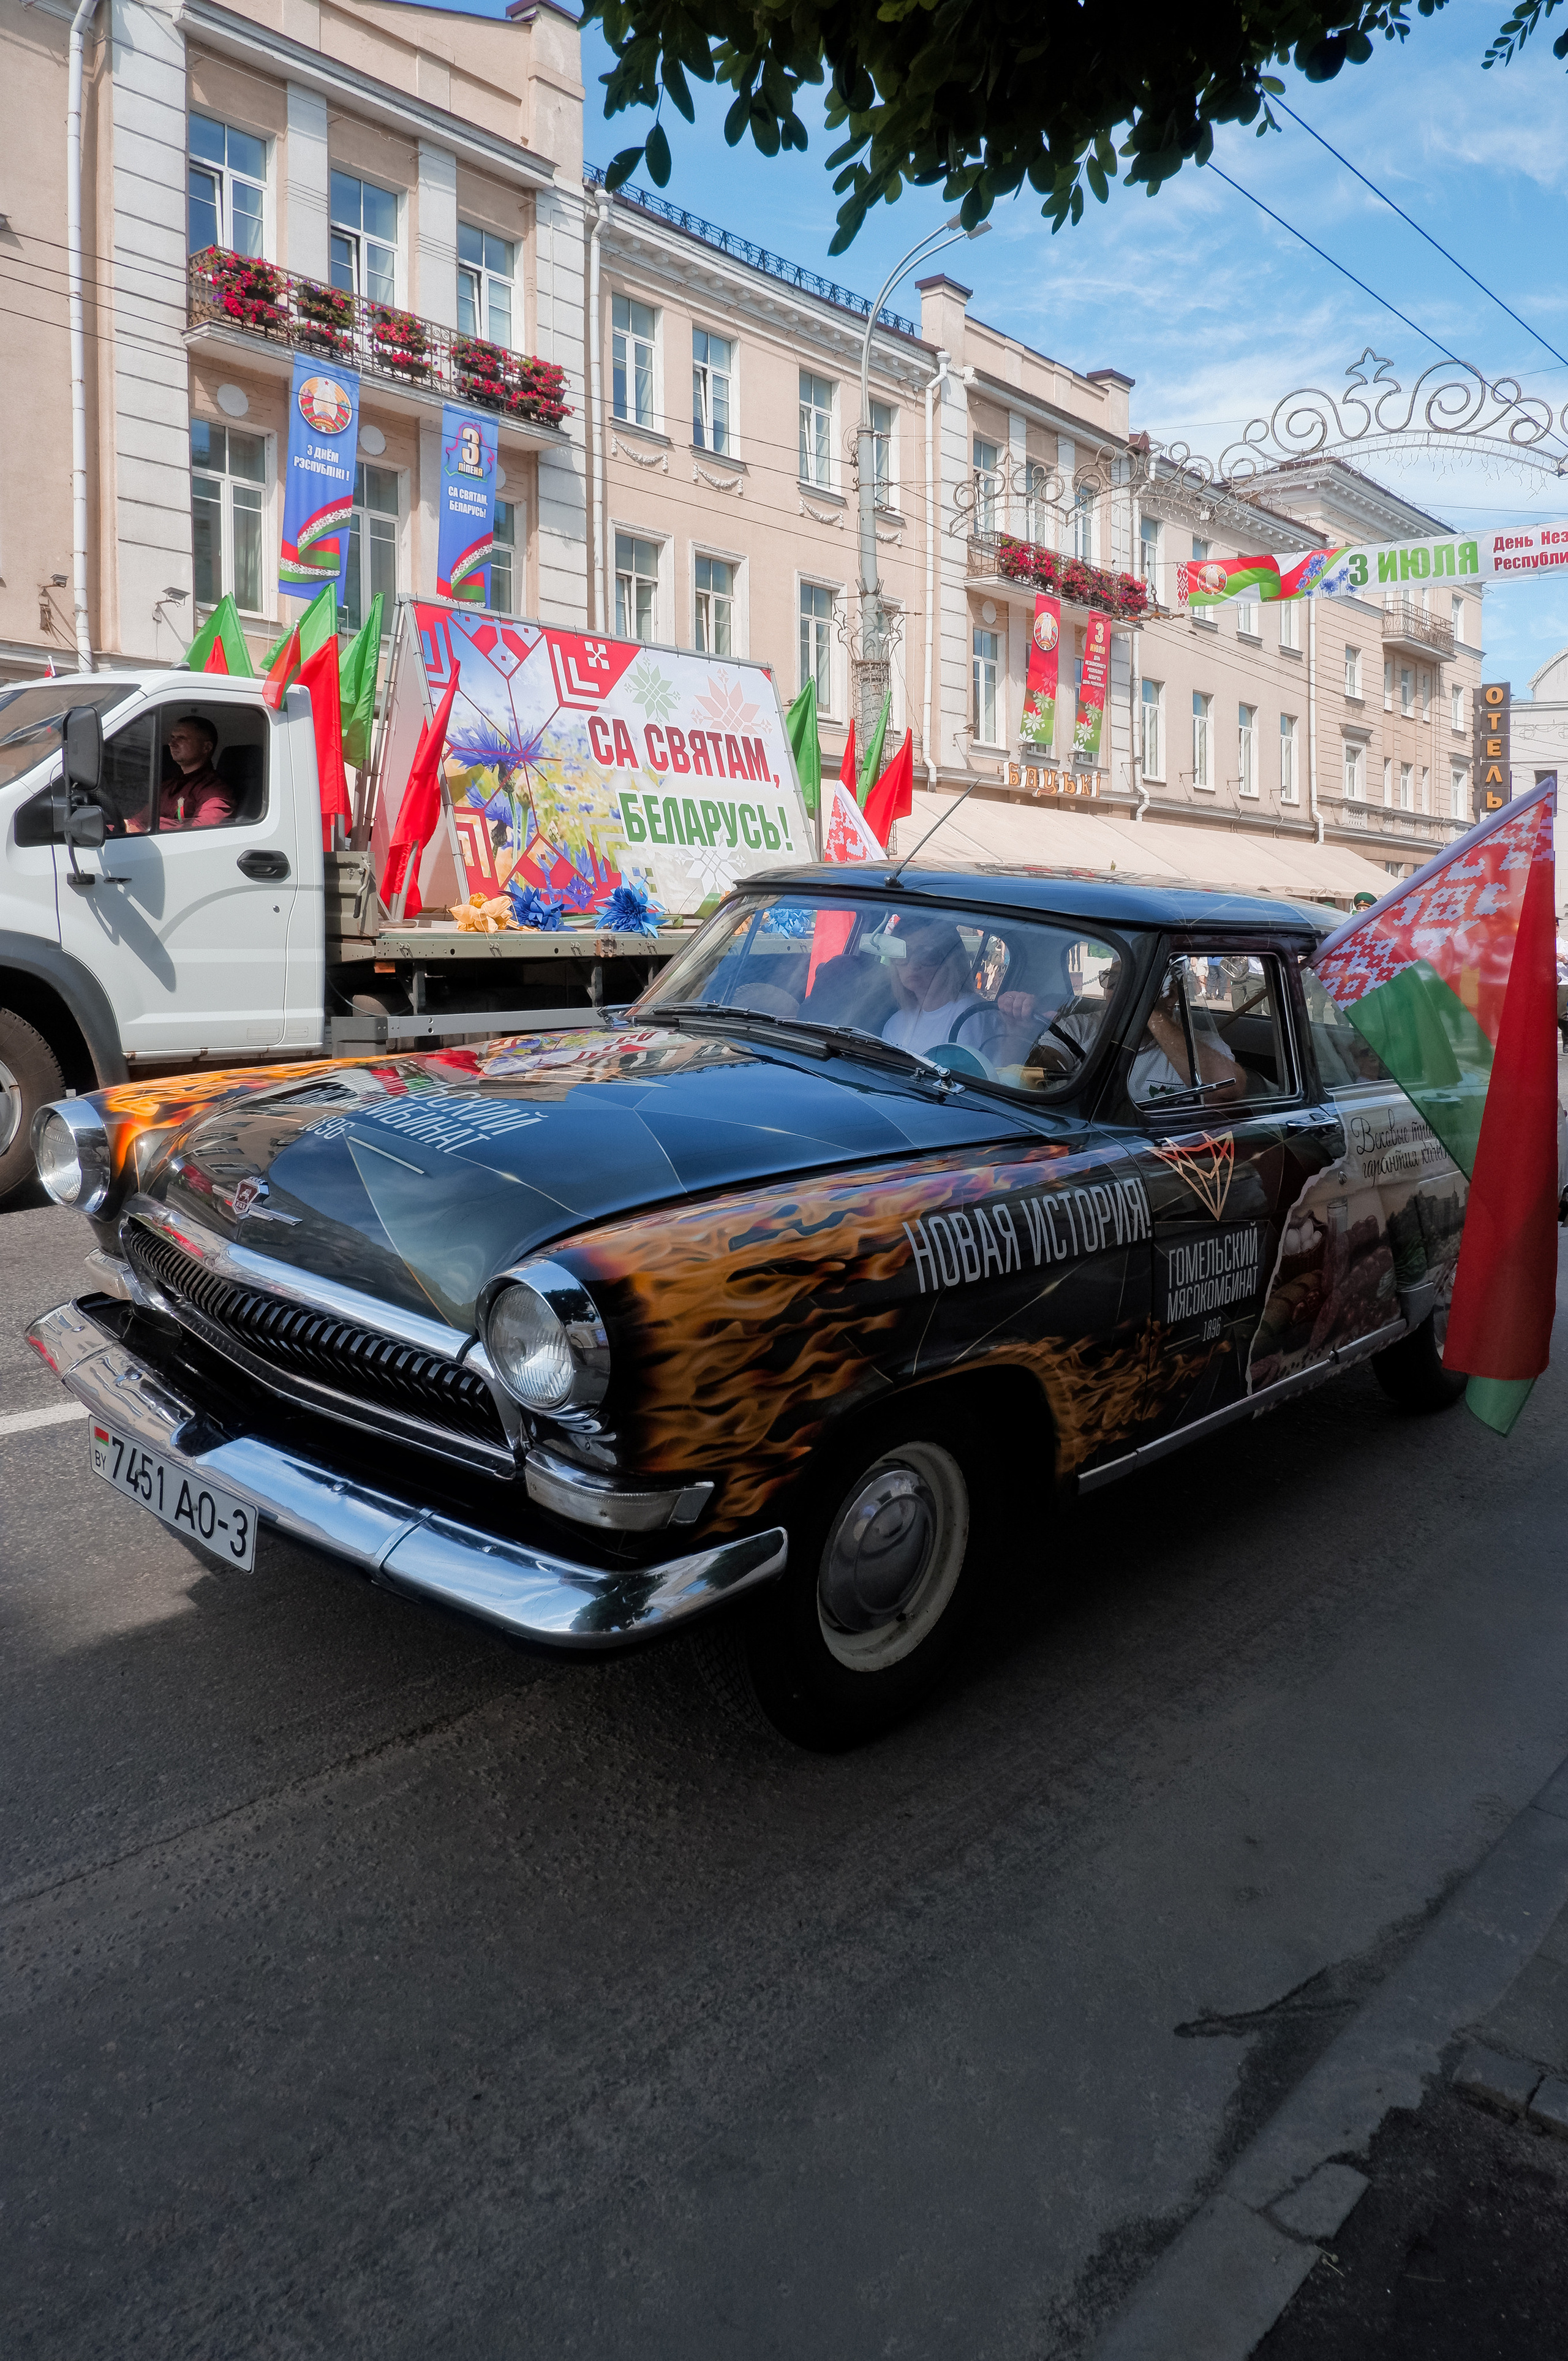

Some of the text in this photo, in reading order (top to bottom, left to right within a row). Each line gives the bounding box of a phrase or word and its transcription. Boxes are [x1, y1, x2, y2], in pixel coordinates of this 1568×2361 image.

[314, 447, 339, 464] ДНЁМ
[462, 427, 480, 466] 3
[448, 485, 488, 506] СА СВЯТАМ,
[449, 500, 487, 518] БЕЛАРУСЬ!
[1348, 541, 1479, 587] 3 ИЮЛЯ
[1493, 536, 1534, 553] День
[1090, 643, 1106, 655] ИЮЛЯ
[1095, 622, 1104, 643] 3
[587, 716, 780, 788] СА СВЯТАМ,
[1485, 687, 1504, 809] ОТЕЛЬ
[619, 793, 794, 852] БЕЛАРУСЬ!
[298, 1113, 356, 1140] 1896
[1362, 1149, 1419, 1189] гарантия
[902, 1177, 1153, 1293] НОВАЯ ИСТОРИЯ!
[1168, 1221, 1258, 1290] ГОМЕЛЬСКИЙ
[1167, 1265, 1259, 1324] МЯСОКОМБИНАТ
[1202, 1316, 1222, 1342] 1896
[94, 1449, 107, 1471] BY
[112, 1435, 165, 1511] 7451
